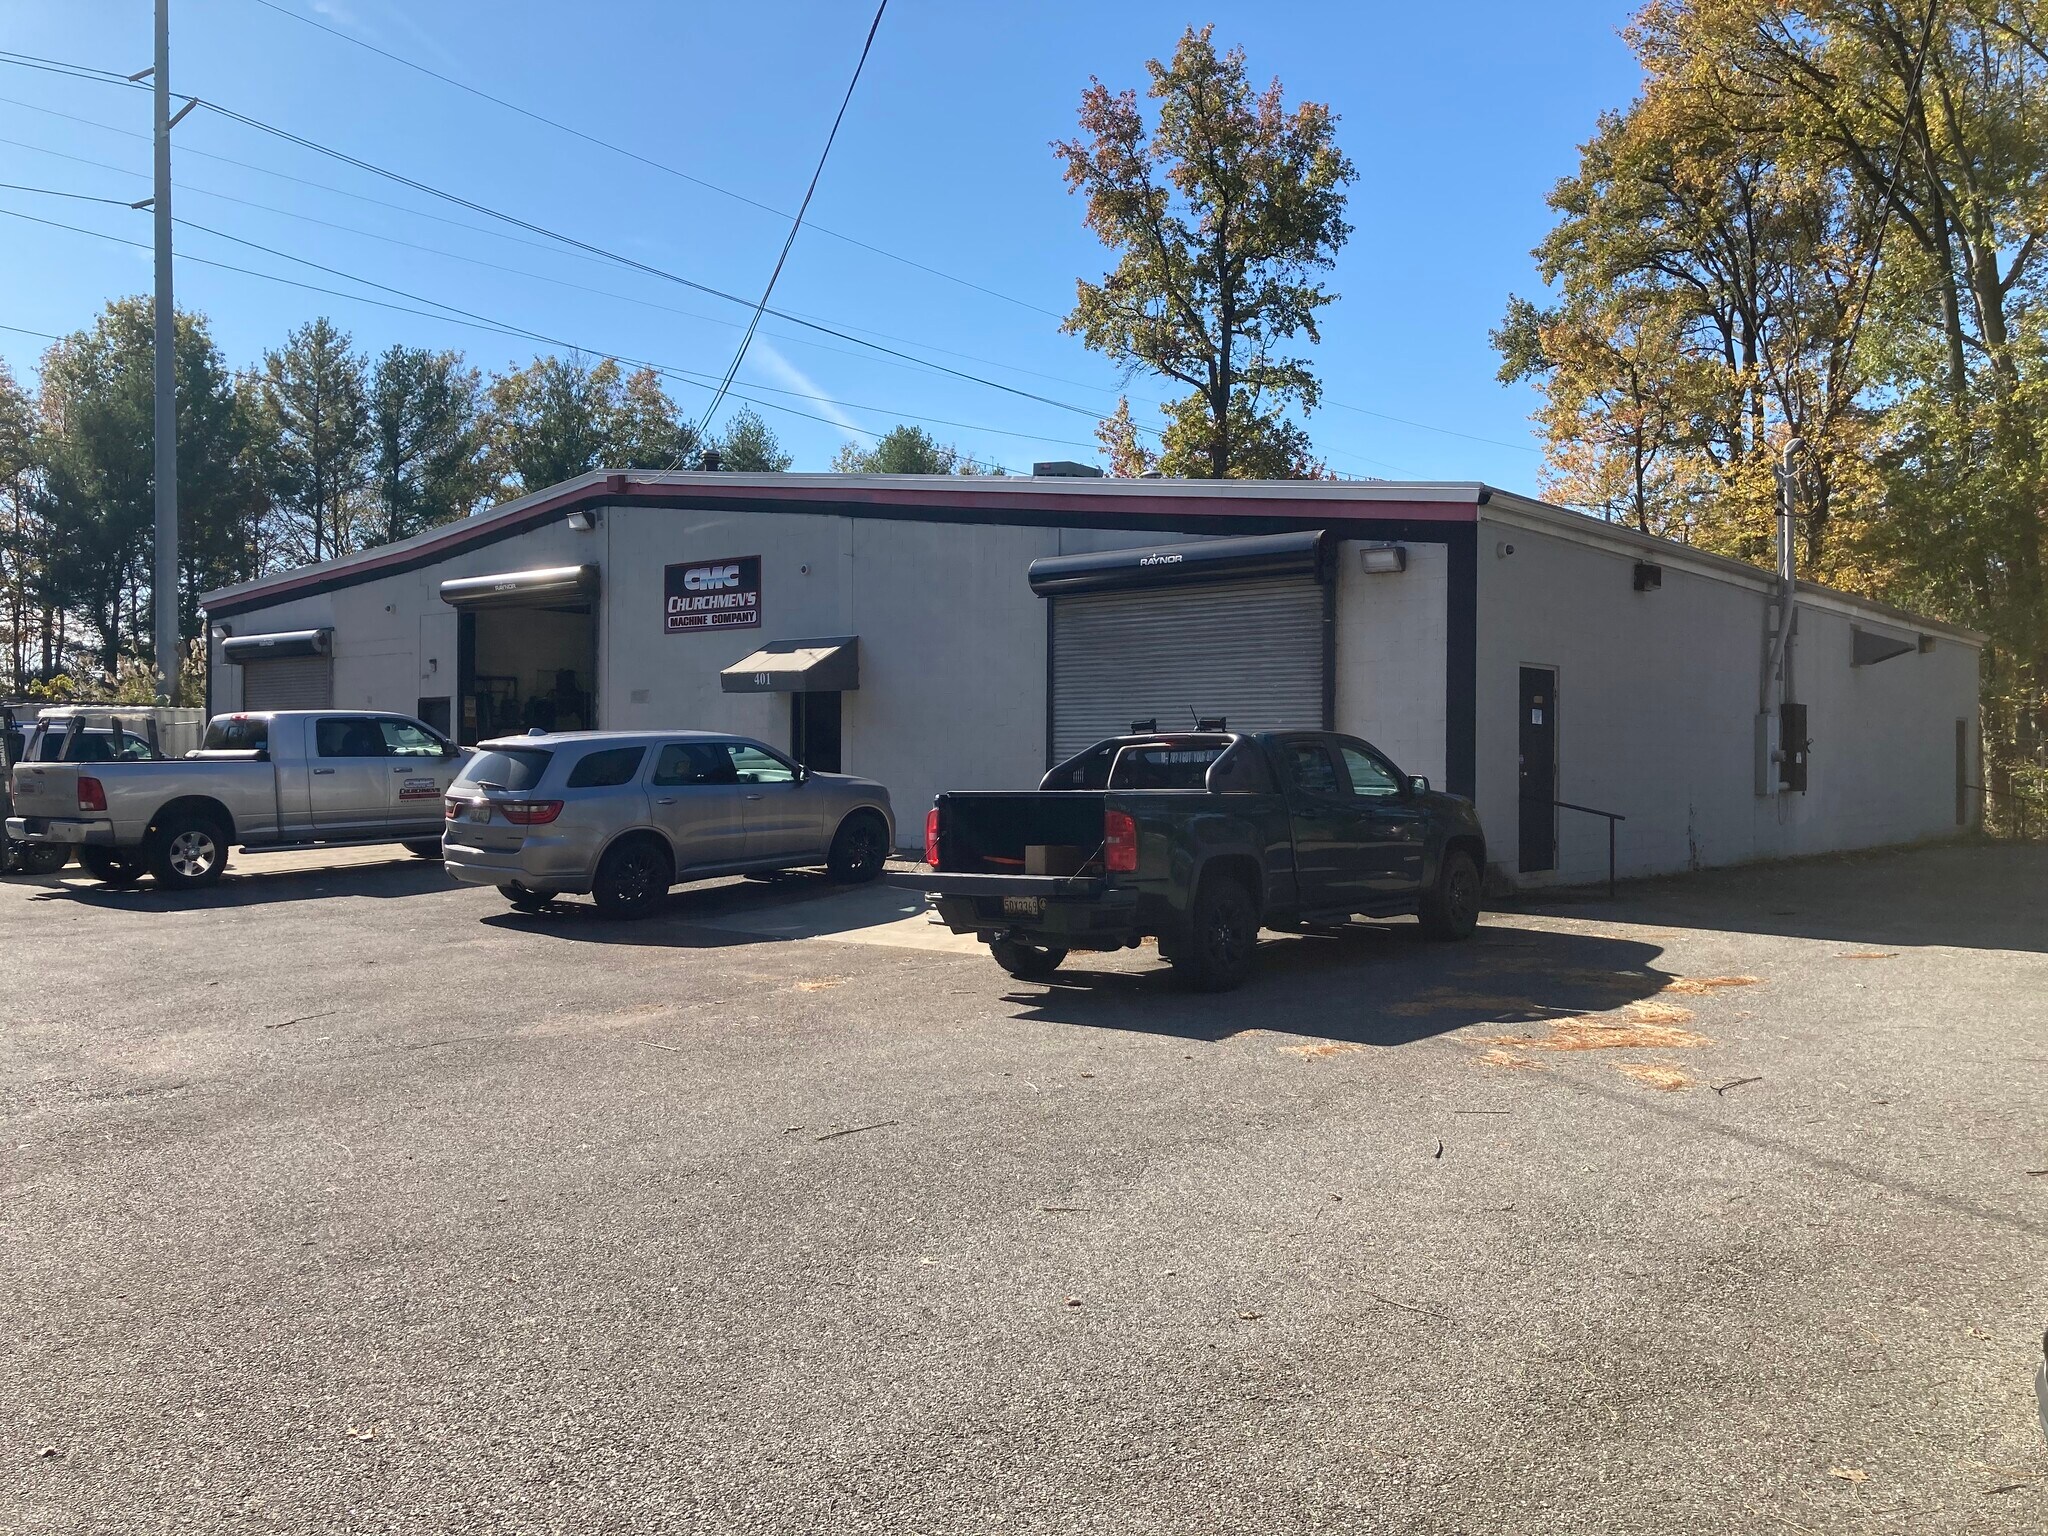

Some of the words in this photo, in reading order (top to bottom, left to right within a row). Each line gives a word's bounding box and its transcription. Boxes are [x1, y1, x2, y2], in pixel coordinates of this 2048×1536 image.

[1140, 555, 1182, 566] RAYNOR
[684, 565, 739, 590] CMC
[668, 592, 757, 613] CHURCHMEN'S
[670, 615, 708, 627] MACHINE
[711, 612, 755, 624] COMPANY
[754, 672, 771, 685] 401
